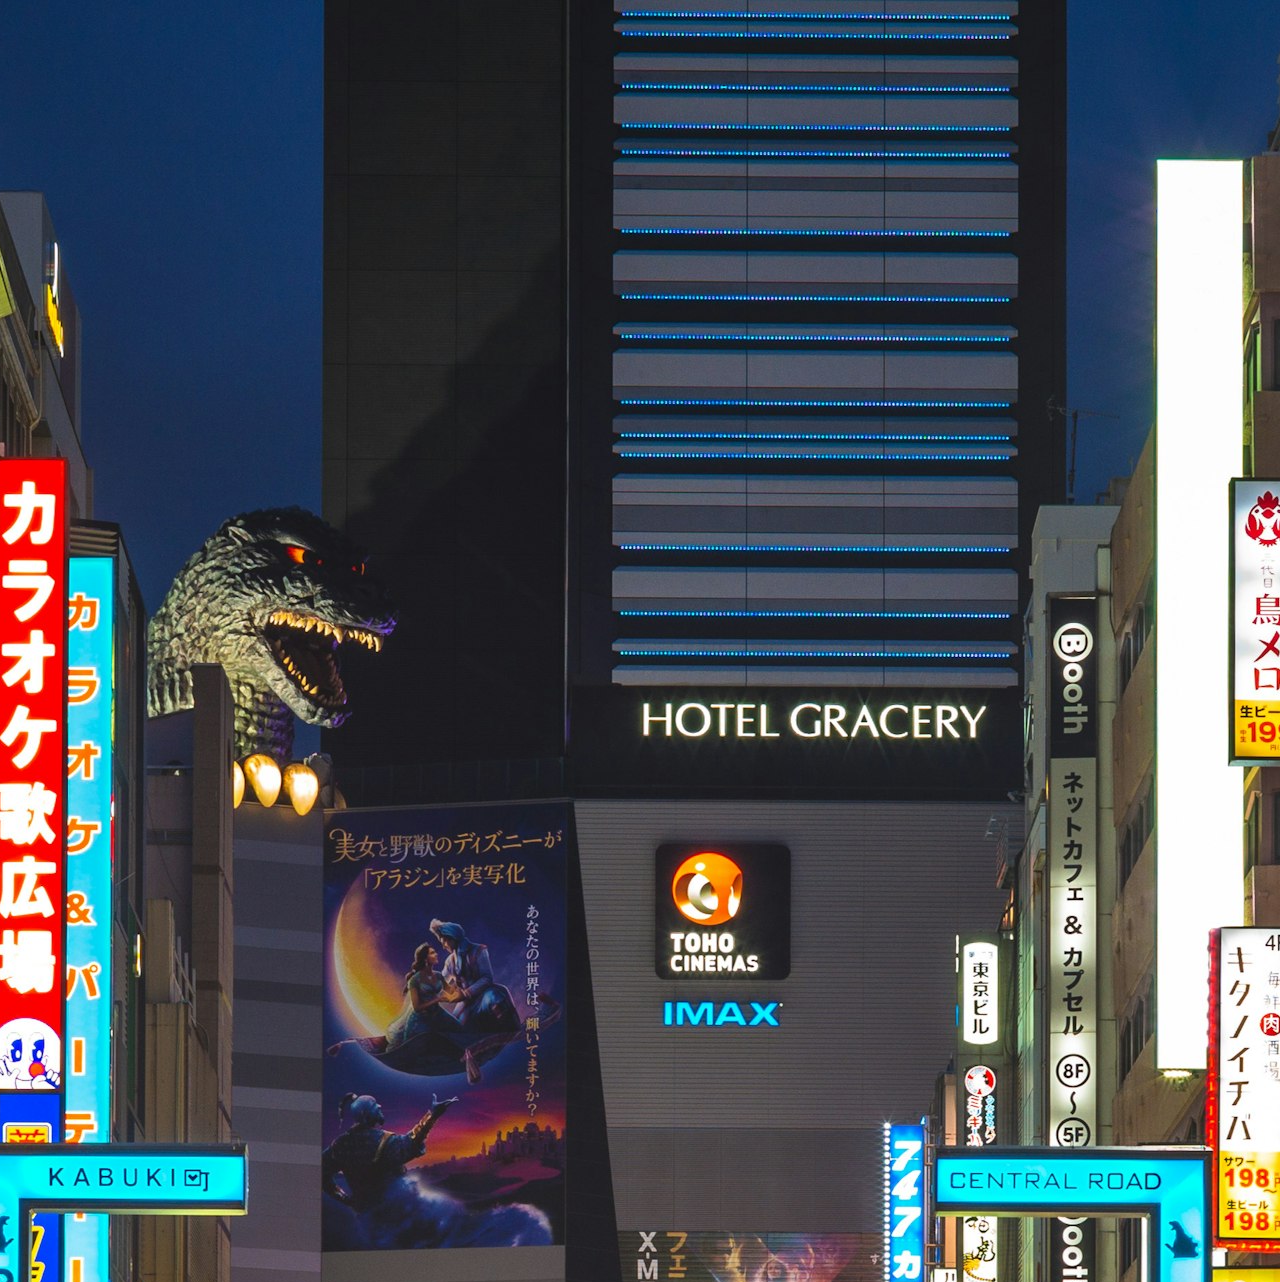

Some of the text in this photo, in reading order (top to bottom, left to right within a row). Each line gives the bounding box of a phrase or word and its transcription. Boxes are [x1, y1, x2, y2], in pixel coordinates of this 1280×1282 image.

[1052, 621, 1094, 735] Booth
[0, 480, 58, 996] カラオケ歌広場
[642, 702, 988, 739] HOTEL GRACERY
[329, 828, 562, 864] 美女と野獣のディズニーが
[1062, 771, 1085, 903] ネットカフェ
[363, 861, 526, 891] 「アラジン」を実写化
[670, 932, 736, 954] TOHO
[670, 954, 760, 973] CINEMAS
[663, 1001, 783, 1026] IMAX
[972, 961, 990, 1035] 東京ビル
[1062, 947, 1084, 1037] カプセル
[1227, 946, 1253, 1141] キタノイチバ
[891, 1139, 922, 1240] 747
[949, 1172, 1163, 1191] CENTRAL ROAD
